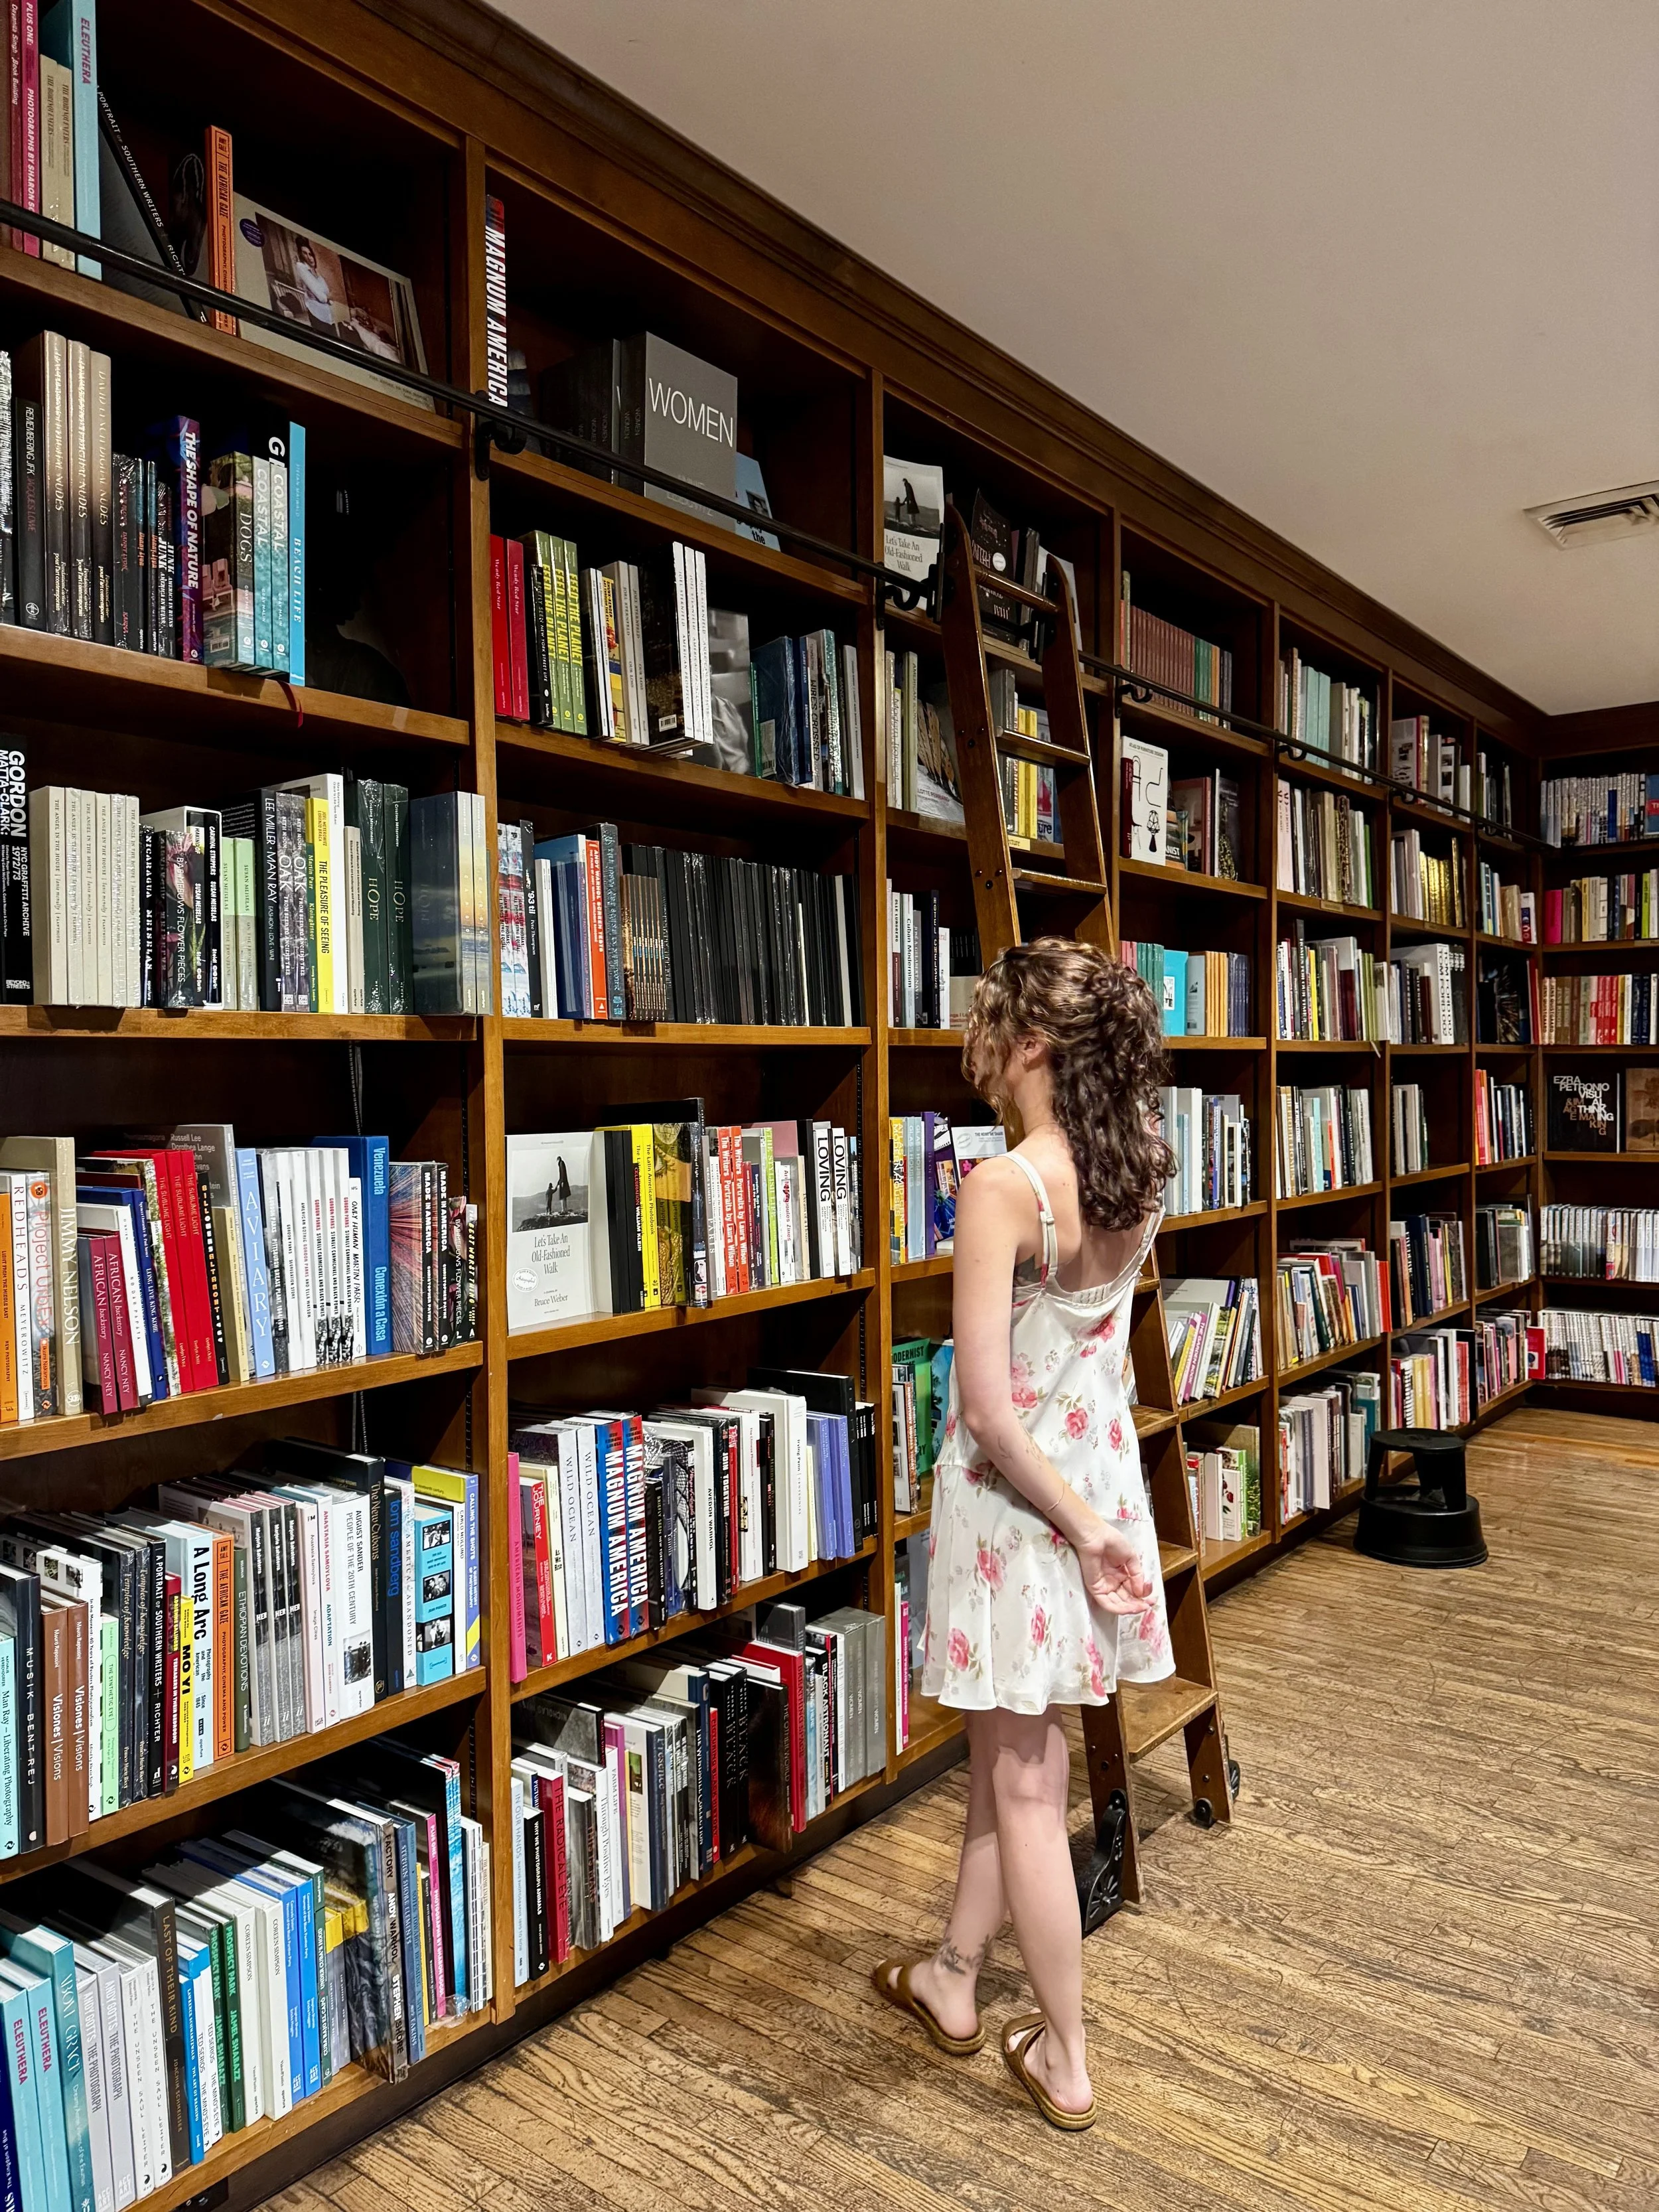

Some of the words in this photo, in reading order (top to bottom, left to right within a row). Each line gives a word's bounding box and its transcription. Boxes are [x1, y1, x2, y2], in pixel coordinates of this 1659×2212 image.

[81, 17, 91, 84] ELEUTHERA
[27, 151, 35, 162] BY
[485, 225, 507, 317] MAGNUM
[486, 316, 508, 407] AMERICA
[648, 377, 733, 447] WOMEN
[185, 431, 196, 460] THE
[185, 459, 197, 506] SHAPE
[186, 508, 197, 529] OF
[257, 468, 269, 546] COASTAL
[240, 512, 252, 563] DOGS
[885, 546, 922, 563] Old-Fashioned
[886, 535, 897, 546] Let's
[898, 537, 910, 549] Take
[911, 541, 920, 551] An
[186, 531, 198, 589] NATURE
[293, 538, 302, 588] BEACH
[897, 559, 911, 572] Walk
[569, 573, 579, 599] FEED
[569, 601, 580, 623] THE
[571, 624, 583, 666] PLANET
[8, 751, 27, 837] GORDON
[265, 798, 275, 813] LEE
[265, 814, 276, 844] MILLER
[12, 846, 21, 881] 1972/73
[266, 851, 276, 880] MAN
[279, 854, 293, 890] OAK
[294, 856, 307, 893] OAK
[319, 860, 327, 874] THE
[176, 876, 184, 915] MEEUWS
[267, 881, 277, 903] RAY
[319, 876, 328, 915] PLEASURE
[368, 877, 380, 921] HOPE
[177, 917, 186, 948] FLOWER
[321, 917, 328, 928] OF
[177, 949, 186, 982] PIECES
[373, 1147, 386, 1196] Venezuela
[818, 1138, 831, 1202] LOVING
[834, 1136, 846, 1200] LOVING
[161, 1191, 170, 1218] SUBLIME
[13, 1187, 27, 1291] REDHEADS
[60, 1208, 77, 1263] JIMMY
[532, 1245, 570, 1262] Old-Fashioned
[534, 1234, 546, 1248] Let's
[547, 1233, 560, 1246] Take
[560, 1232, 568, 1244] An
[246, 1191, 267, 1337] AVIARY
[543, 1262, 558, 1274] Walk
[375, 1266, 388, 1310] Conexión
[534, 1298, 549, 1307] Bruce
[551, 1293, 568, 1303] Weber
[62, 1270, 80, 1346] NELSON
[94, 1255, 106, 1306] AFRICAN
[102, 1353, 111, 1379] NANCY
[19, 1304, 28, 1375] MEYEROWITZ
[376, 1318, 388, 1342] Casa
[605, 1452, 626, 1530] MAGNUM
[533, 1487, 541, 1540] JOURNEY
[194, 1546, 210, 1559] A
[155, 1563, 164, 1598] PORTRAIT
[193, 1563, 210, 1604] Long
[608, 1534, 628, 1617] AMERICA
[156, 1600, 161, 1609] OF
[155, 1610, 163, 1650] SOUTHERN
[193, 1609, 208, 1641] Arc
[154, 1651, 163, 1686] WRITERS
[181, 1643, 191, 1672] MO
[181, 1676, 190, 1695] YI
[556, 1817, 565, 1880] RADICAL
[388, 1893, 396, 1919] ANDY
[162, 1915, 171, 1945] LAST
[390, 1921, 400, 1964] WARHOL
[165, 1947, 173, 1962] OF
[225, 1925, 234, 1973] PROSPECT
[165, 1965, 175, 2002] THEIR
[227, 1974, 236, 1997] PARK
[392, 1974, 402, 2020] STEPHEN
[169, 2004, 178, 2034] KIND
[230, 2009, 239, 2039] JAMEL
[38, 2006, 52, 2073] ELEUTHERA
